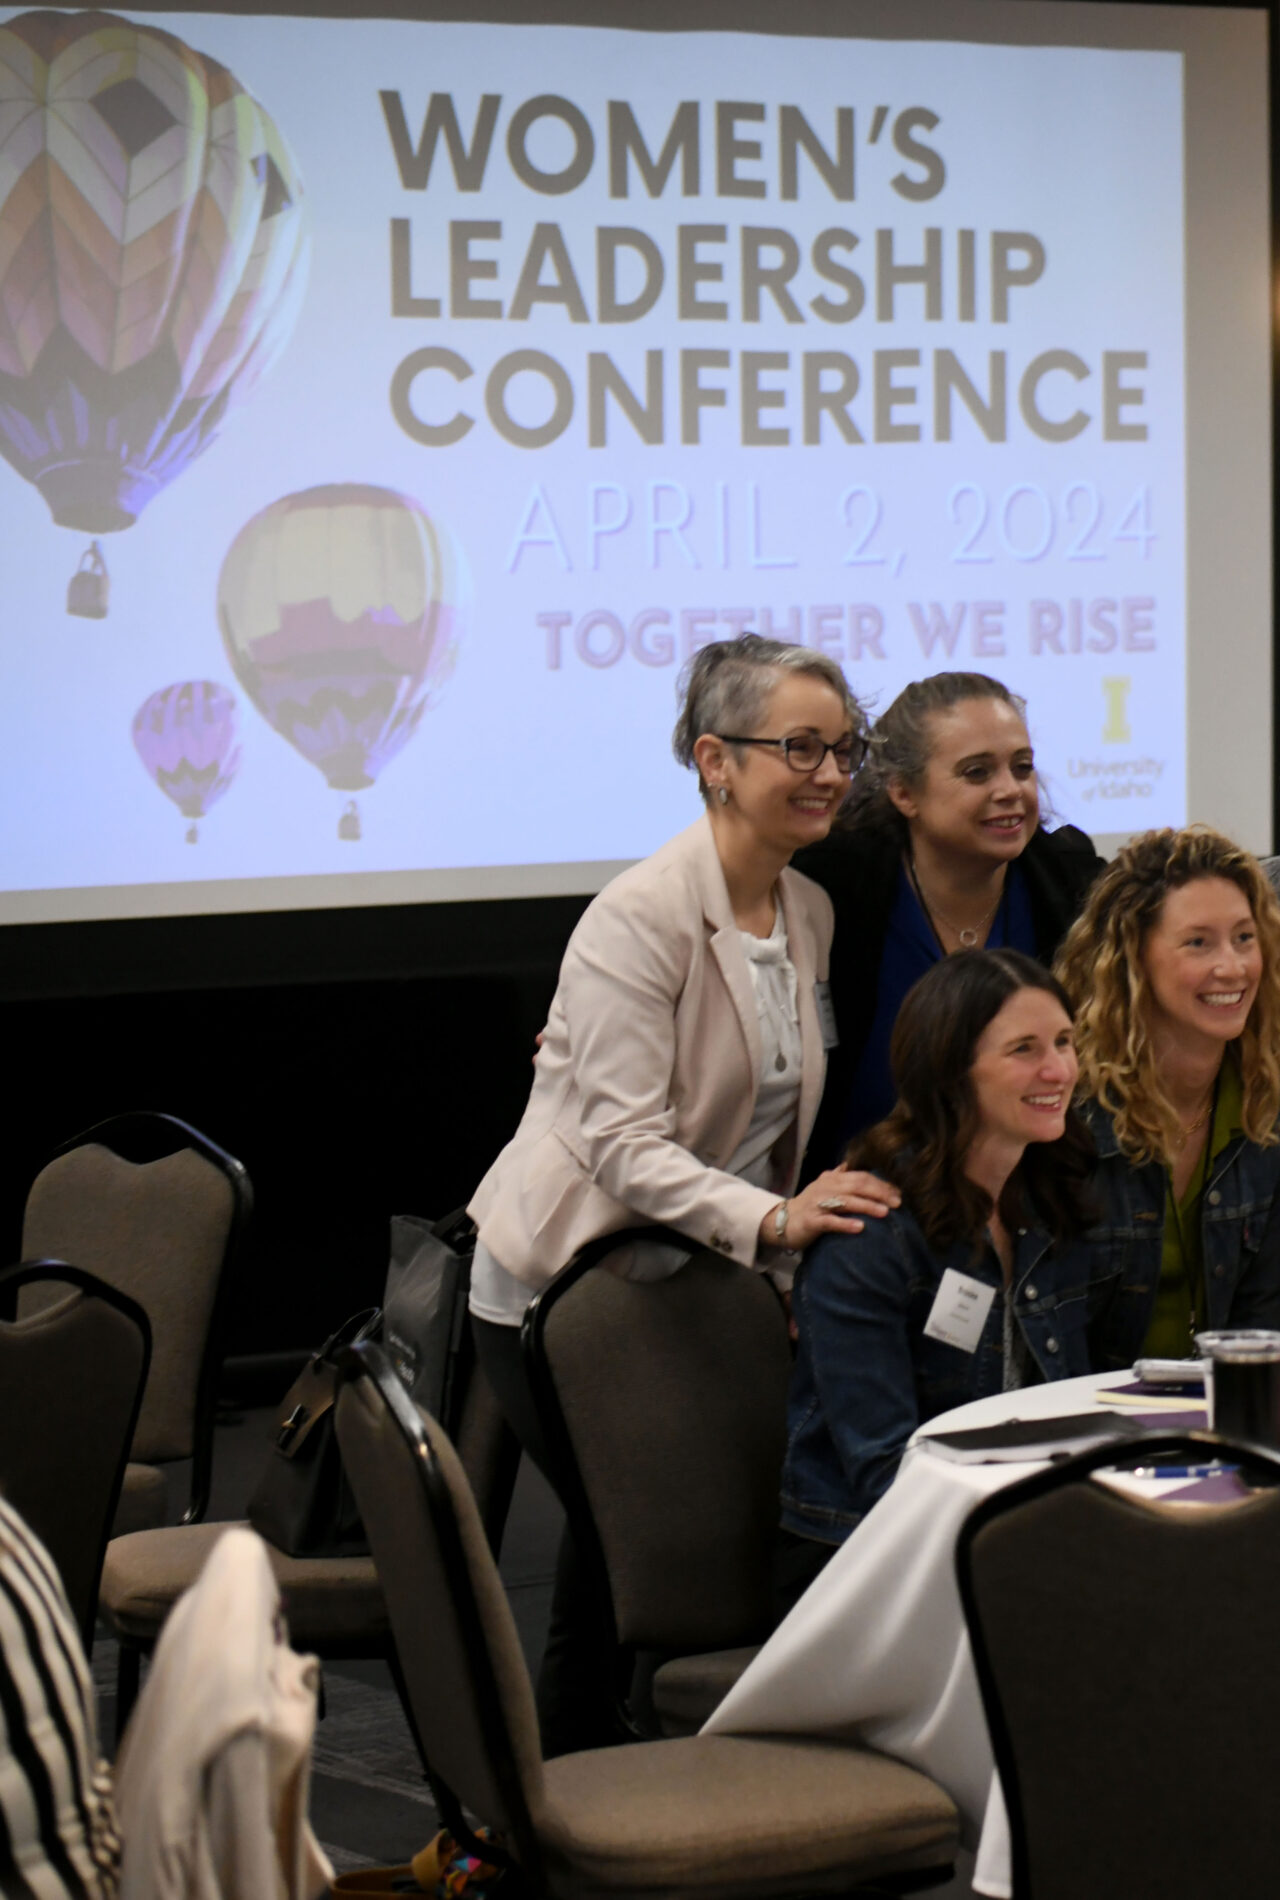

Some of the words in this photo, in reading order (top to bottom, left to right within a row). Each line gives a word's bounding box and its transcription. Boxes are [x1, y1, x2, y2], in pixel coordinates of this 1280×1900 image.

[379, 89, 946, 202] WOMEN'S
[389, 217, 1047, 324] LEADERSHIP
[389, 346, 1149, 449] CONFERENCE
[508, 478, 799, 573] APRIL
[841, 484, 907, 577] 2,
[944, 480, 1158, 563] 2024
[908, 600, 1005, 658] WE
[1029, 597, 1157, 655] RISE
[1066, 757, 1164, 780] University
